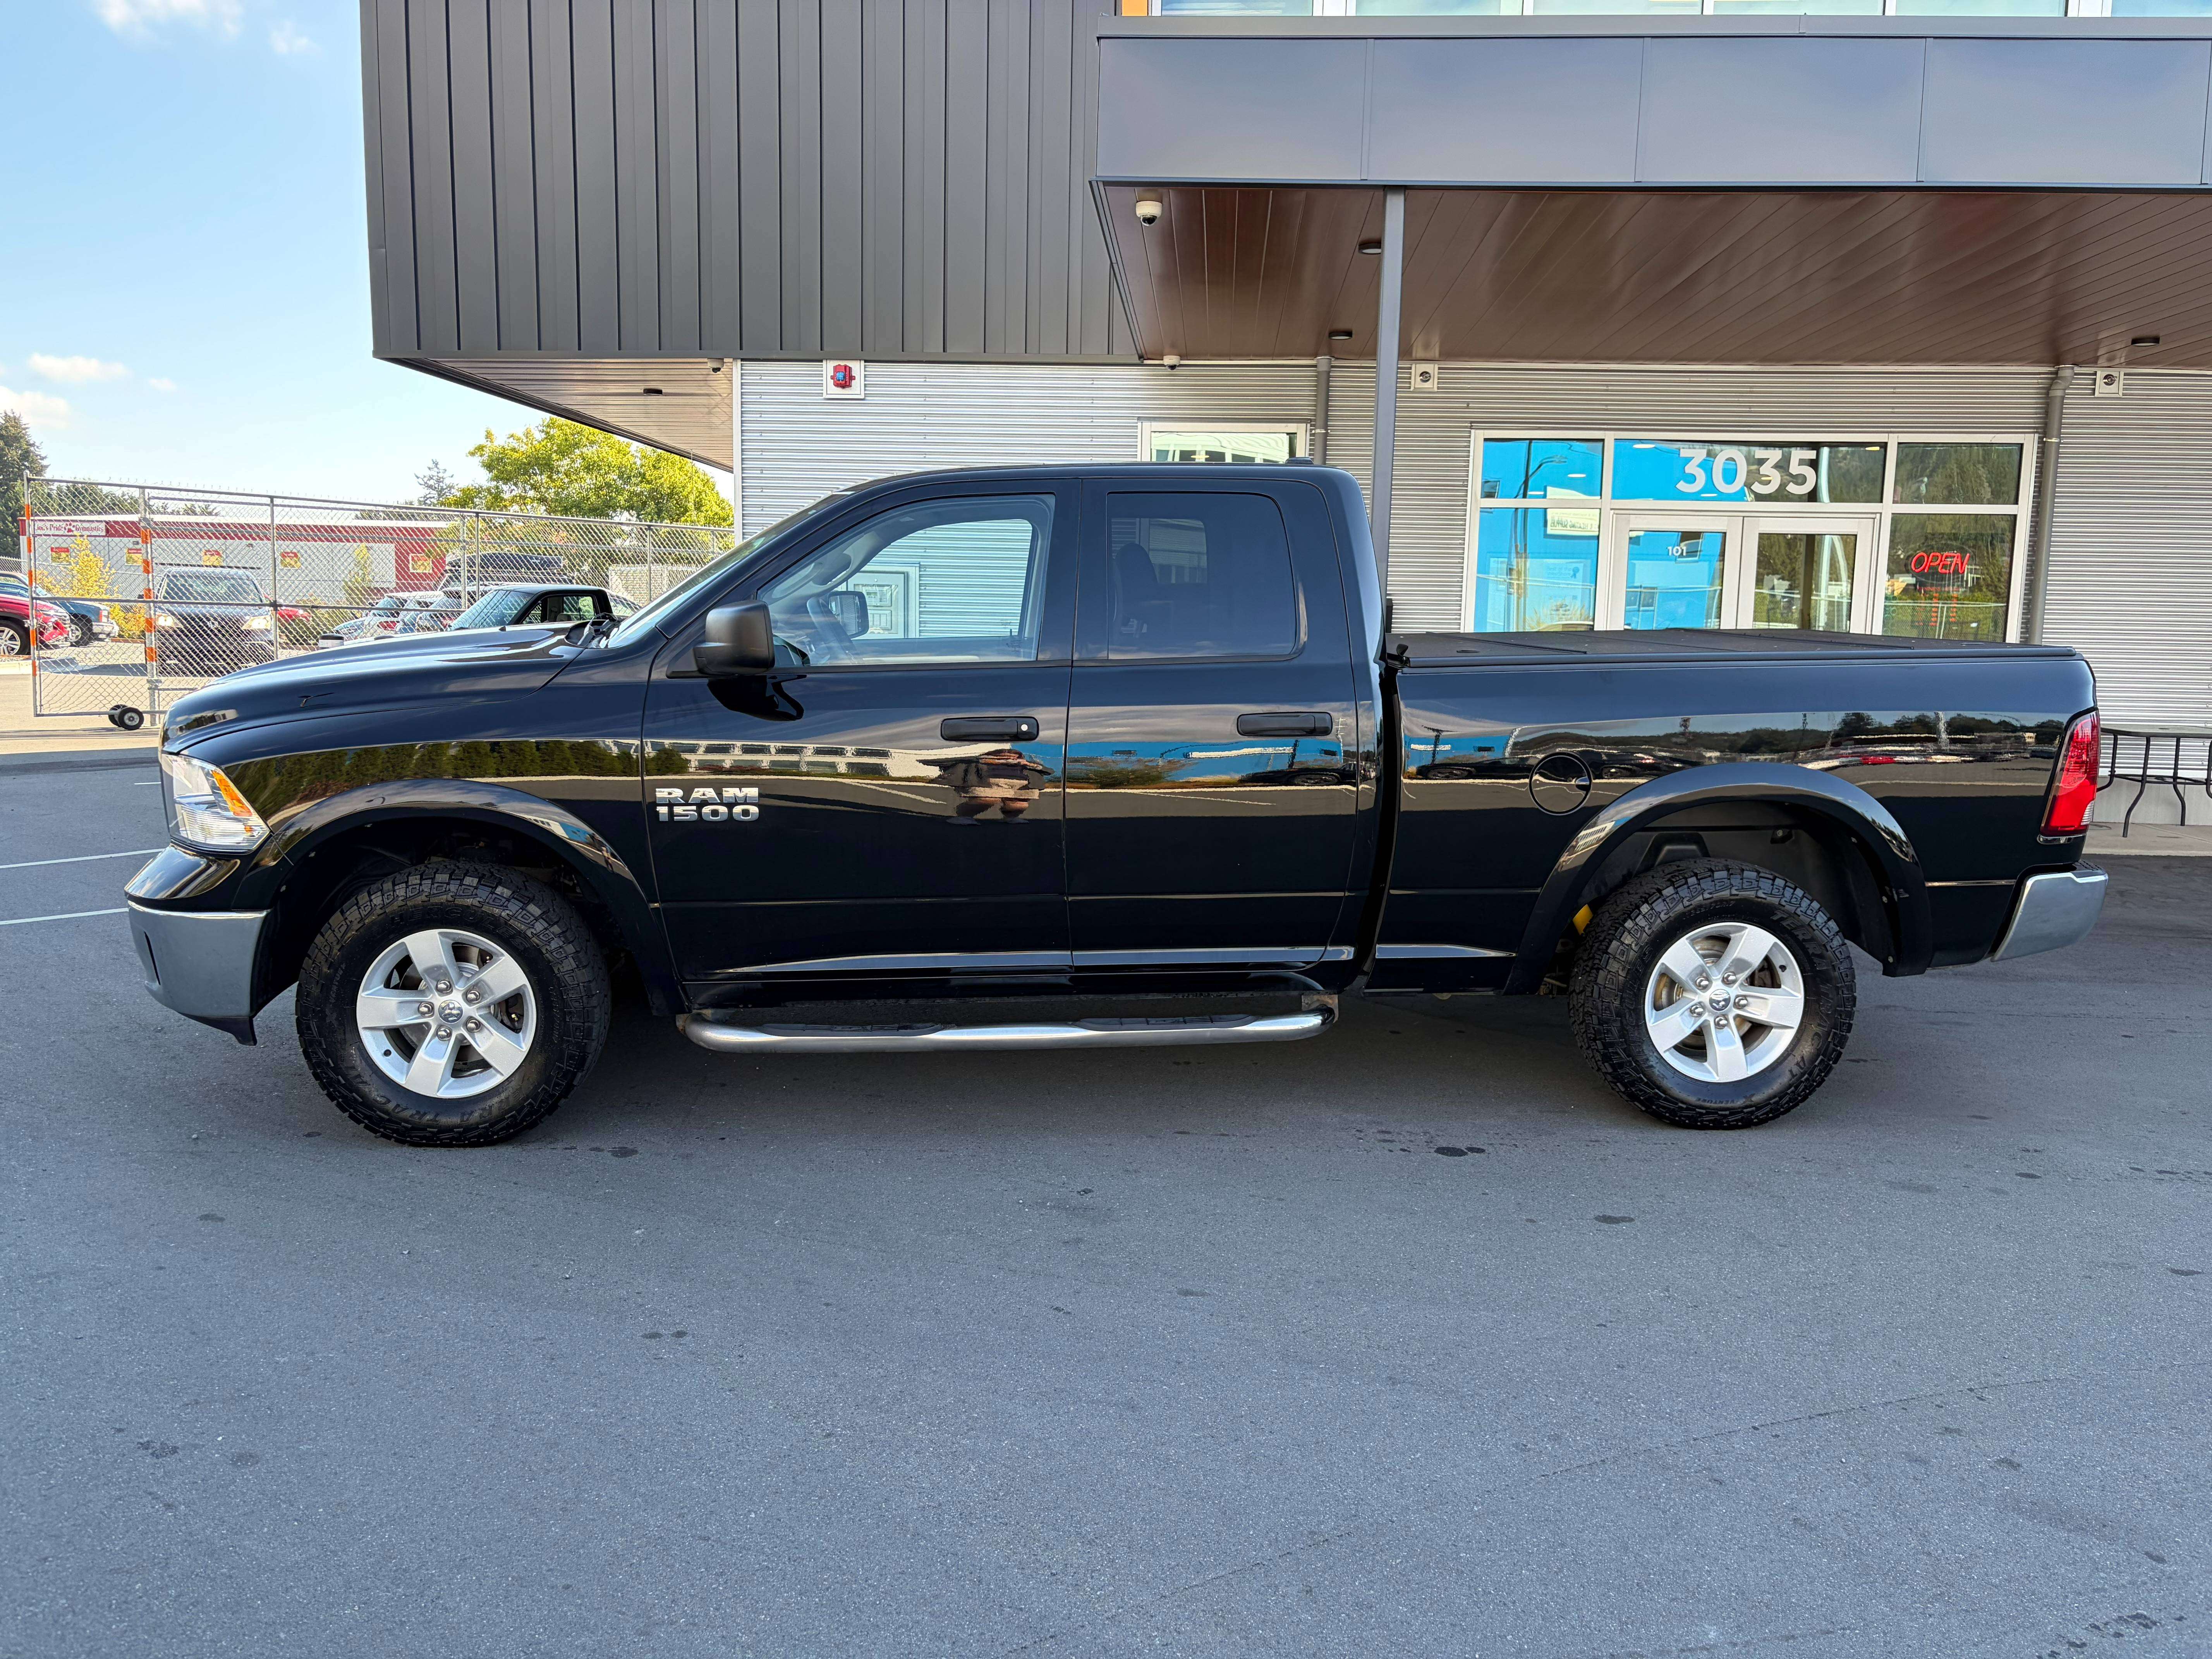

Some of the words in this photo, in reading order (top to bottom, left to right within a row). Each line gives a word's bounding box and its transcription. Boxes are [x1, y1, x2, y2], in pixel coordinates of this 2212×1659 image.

[1676, 448, 1817, 495] 3035
[75, 524, 103, 532] Gymnastics
[1668, 546, 1686, 556] 101
[1911, 552, 1970, 574] OPEN
[656, 787, 759, 803] RAM
[656, 805, 759, 821] 1500
[389, 905, 531, 950] HERCULES
[1769, 910, 1832, 970] TERRA
[1811, 983, 1834, 1049] TRAC
[1787, 1055, 1807, 1082] AT
[372, 1093, 442, 1123] TRAC
